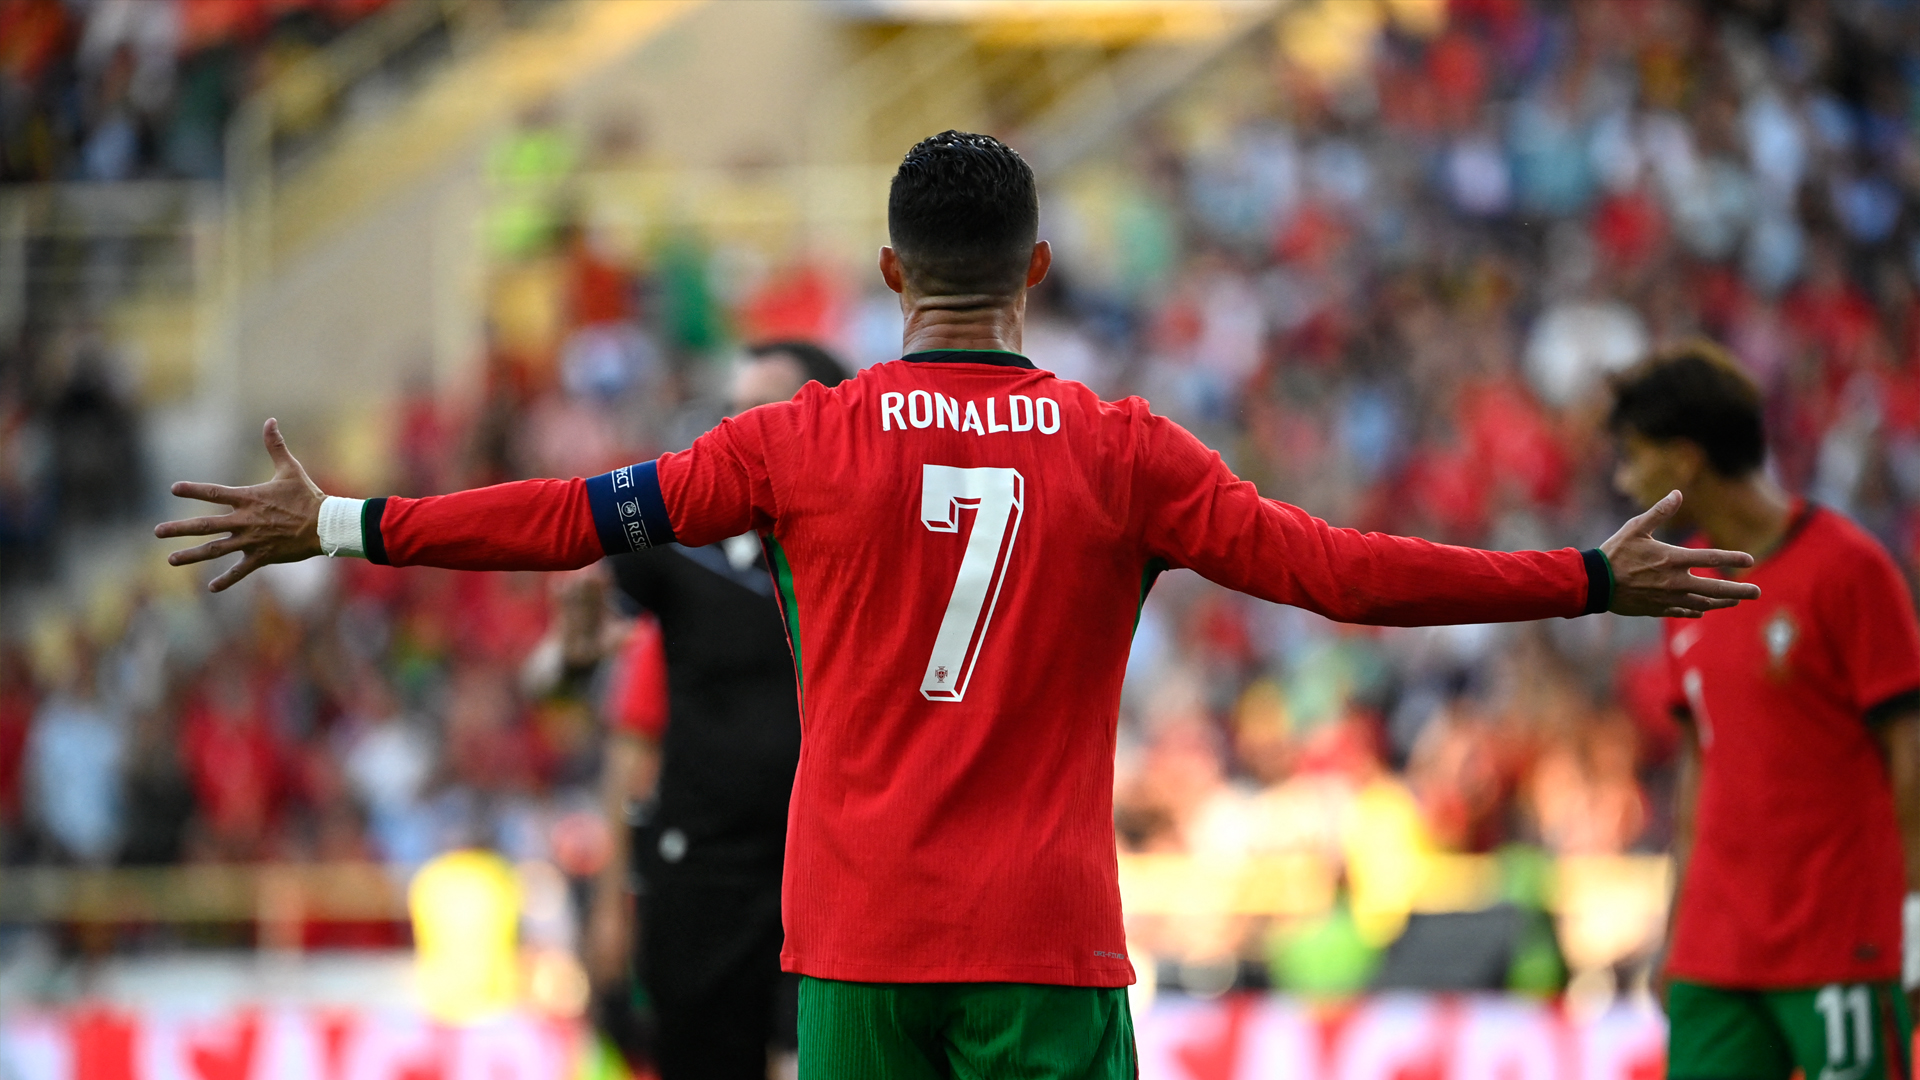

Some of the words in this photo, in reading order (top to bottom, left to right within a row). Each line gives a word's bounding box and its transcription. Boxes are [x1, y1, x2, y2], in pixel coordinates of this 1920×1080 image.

[881, 389, 1061, 436] RONALDO
[919, 464, 1024, 702] 7
[1814, 983, 1873, 1064] 11
